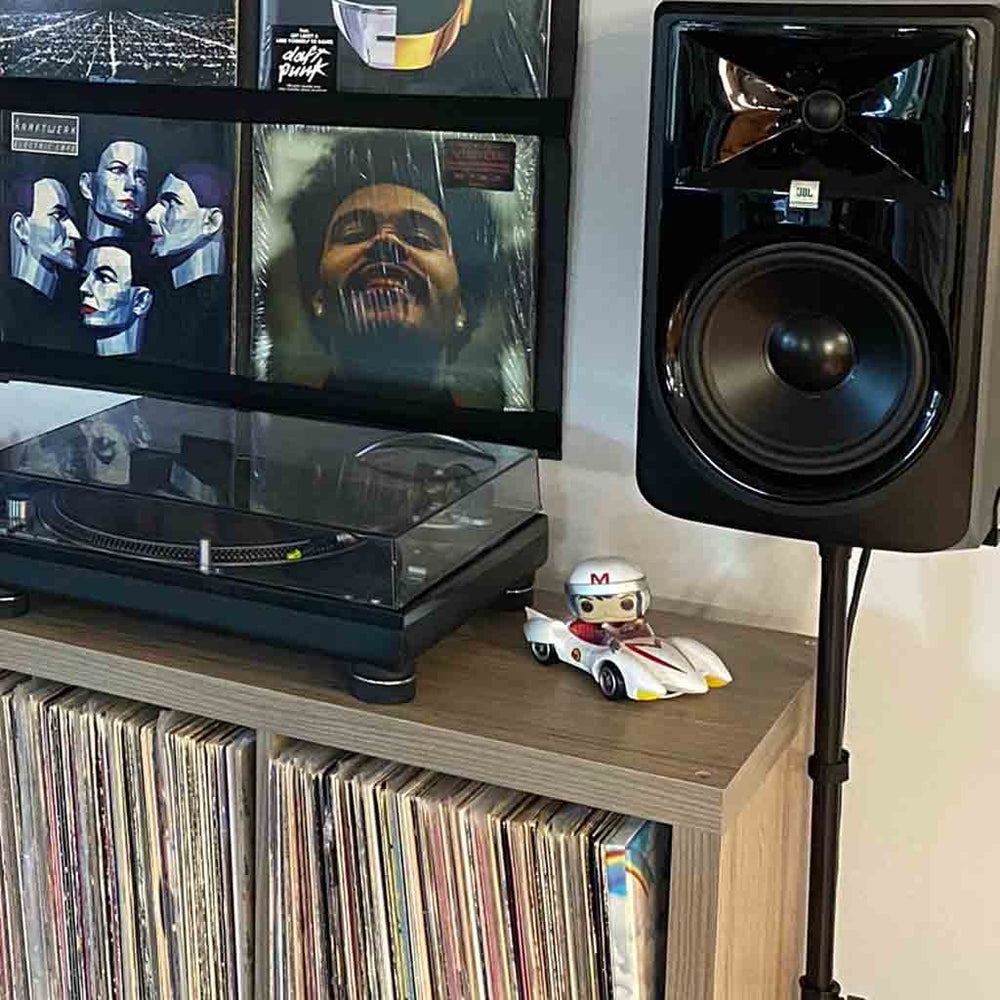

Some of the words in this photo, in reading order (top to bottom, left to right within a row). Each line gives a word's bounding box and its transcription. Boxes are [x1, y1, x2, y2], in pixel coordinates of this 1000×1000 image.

[282, 45, 331, 65] daft
[278, 57, 329, 83] punk
[14, 117, 76, 135] KRAFTWERK
[796, 187, 814, 198] JBL
[590, 573, 610, 585] M
